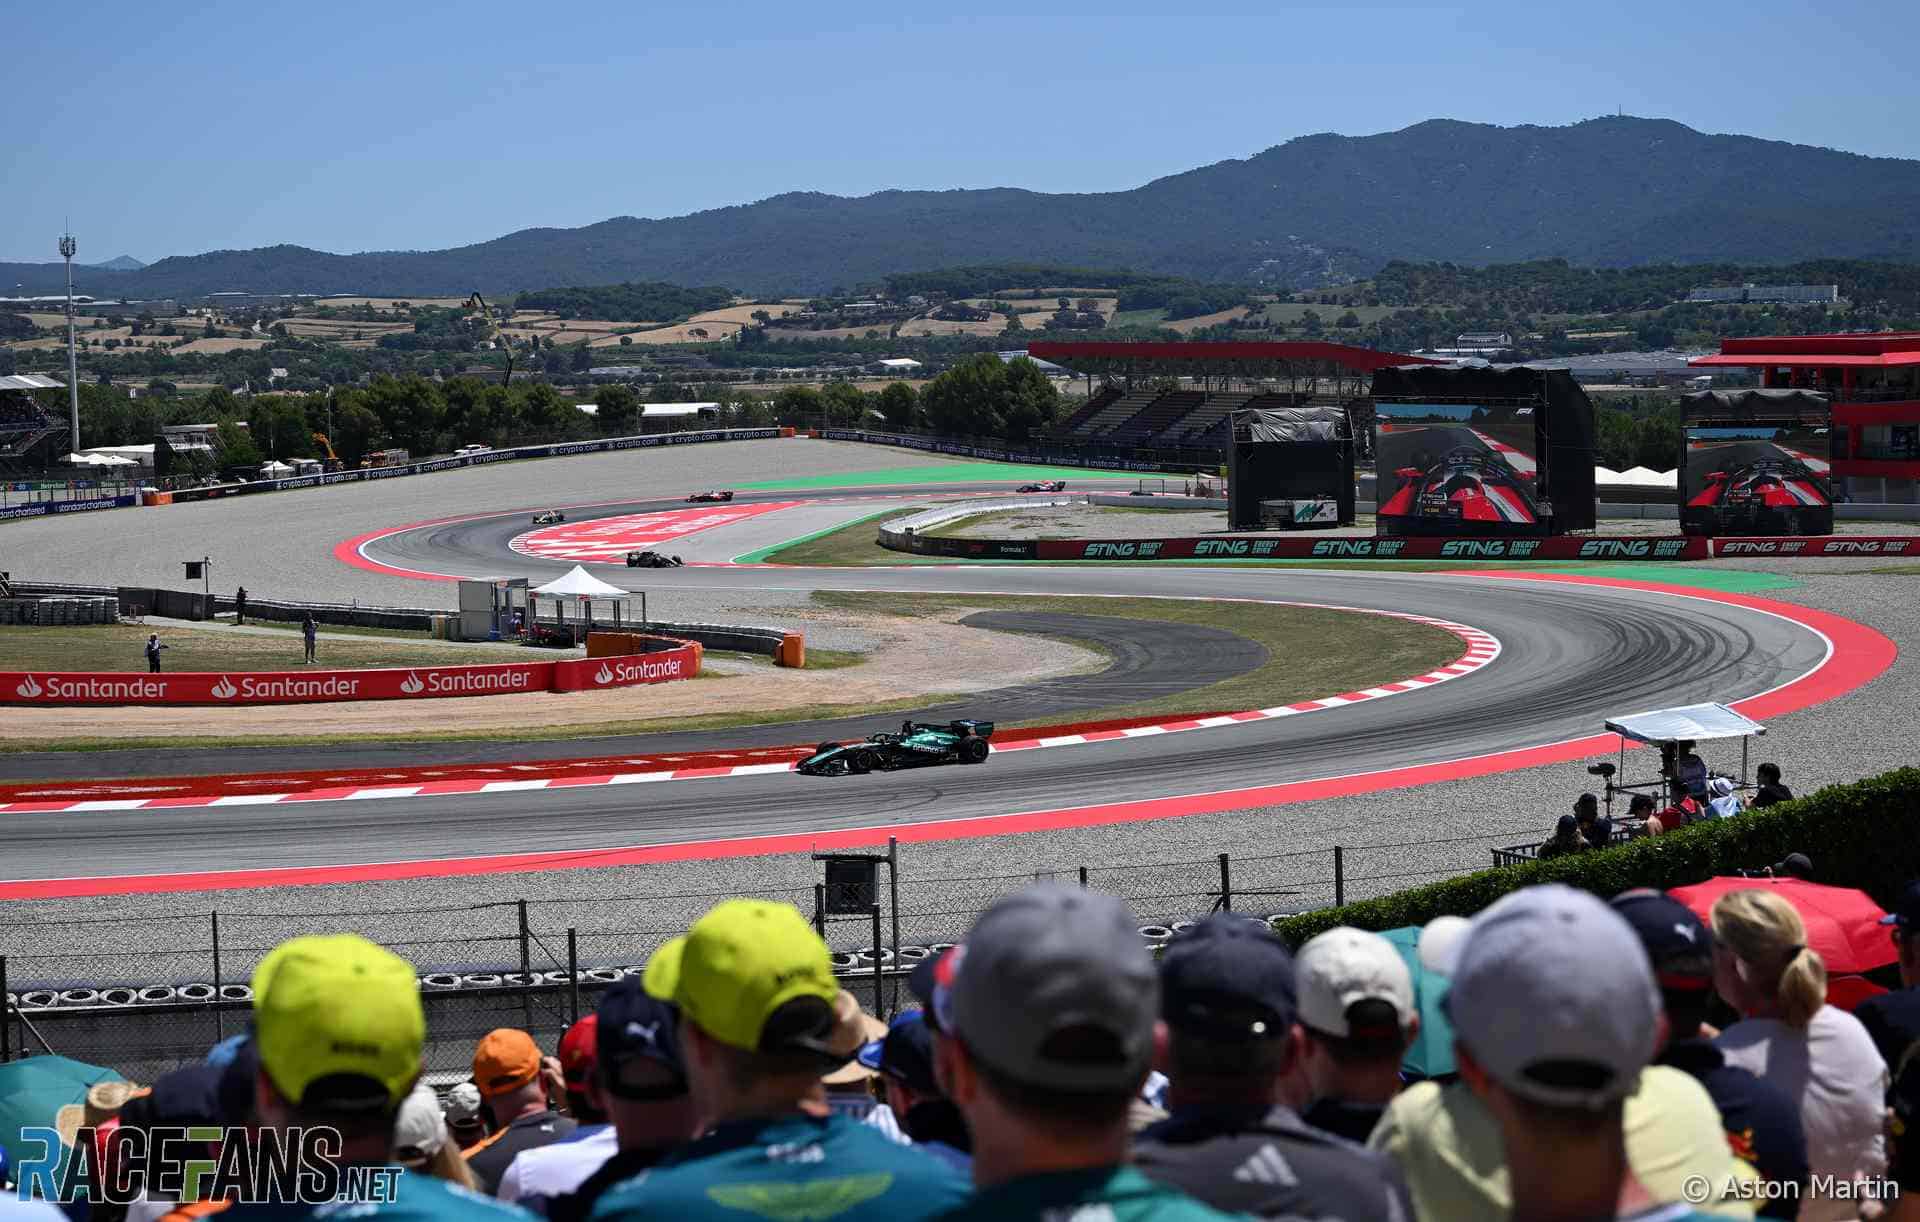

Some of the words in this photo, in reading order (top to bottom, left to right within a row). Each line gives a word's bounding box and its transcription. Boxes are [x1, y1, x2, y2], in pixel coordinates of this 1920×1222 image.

[675, 432, 718, 444] crypto.com
[734, 430, 777, 441] crypto.com
[558, 443, 600, 456] crypto.com
[616, 437, 658, 450] crypto.com
[475, 450, 516, 465] crypto.com
[423, 458, 461, 473] crypto.com
[326, 472, 358, 485] crypto.com
[372, 466, 409, 479] crypto.com
[282, 477, 314, 489] crypto.com
[59, 502, 86, 513] standard
[87, 500, 116, 511] chartered
[1084, 543, 1135, 556] STING
[1194, 541, 1248, 554] STING
[1312, 541, 1372, 554] STING
[1440, 541, 1504, 555] STING
[1580, 541, 1648, 555] STING
[1721, 542, 1776, 552] STING
[1824, 542, 1879, 551] STING
[615, 659, 683, 682] Santander
[242, 676, 360, 698] Santander
[428, 669, 530, 692] Santander
[46, 677, 168, 698] Santander
